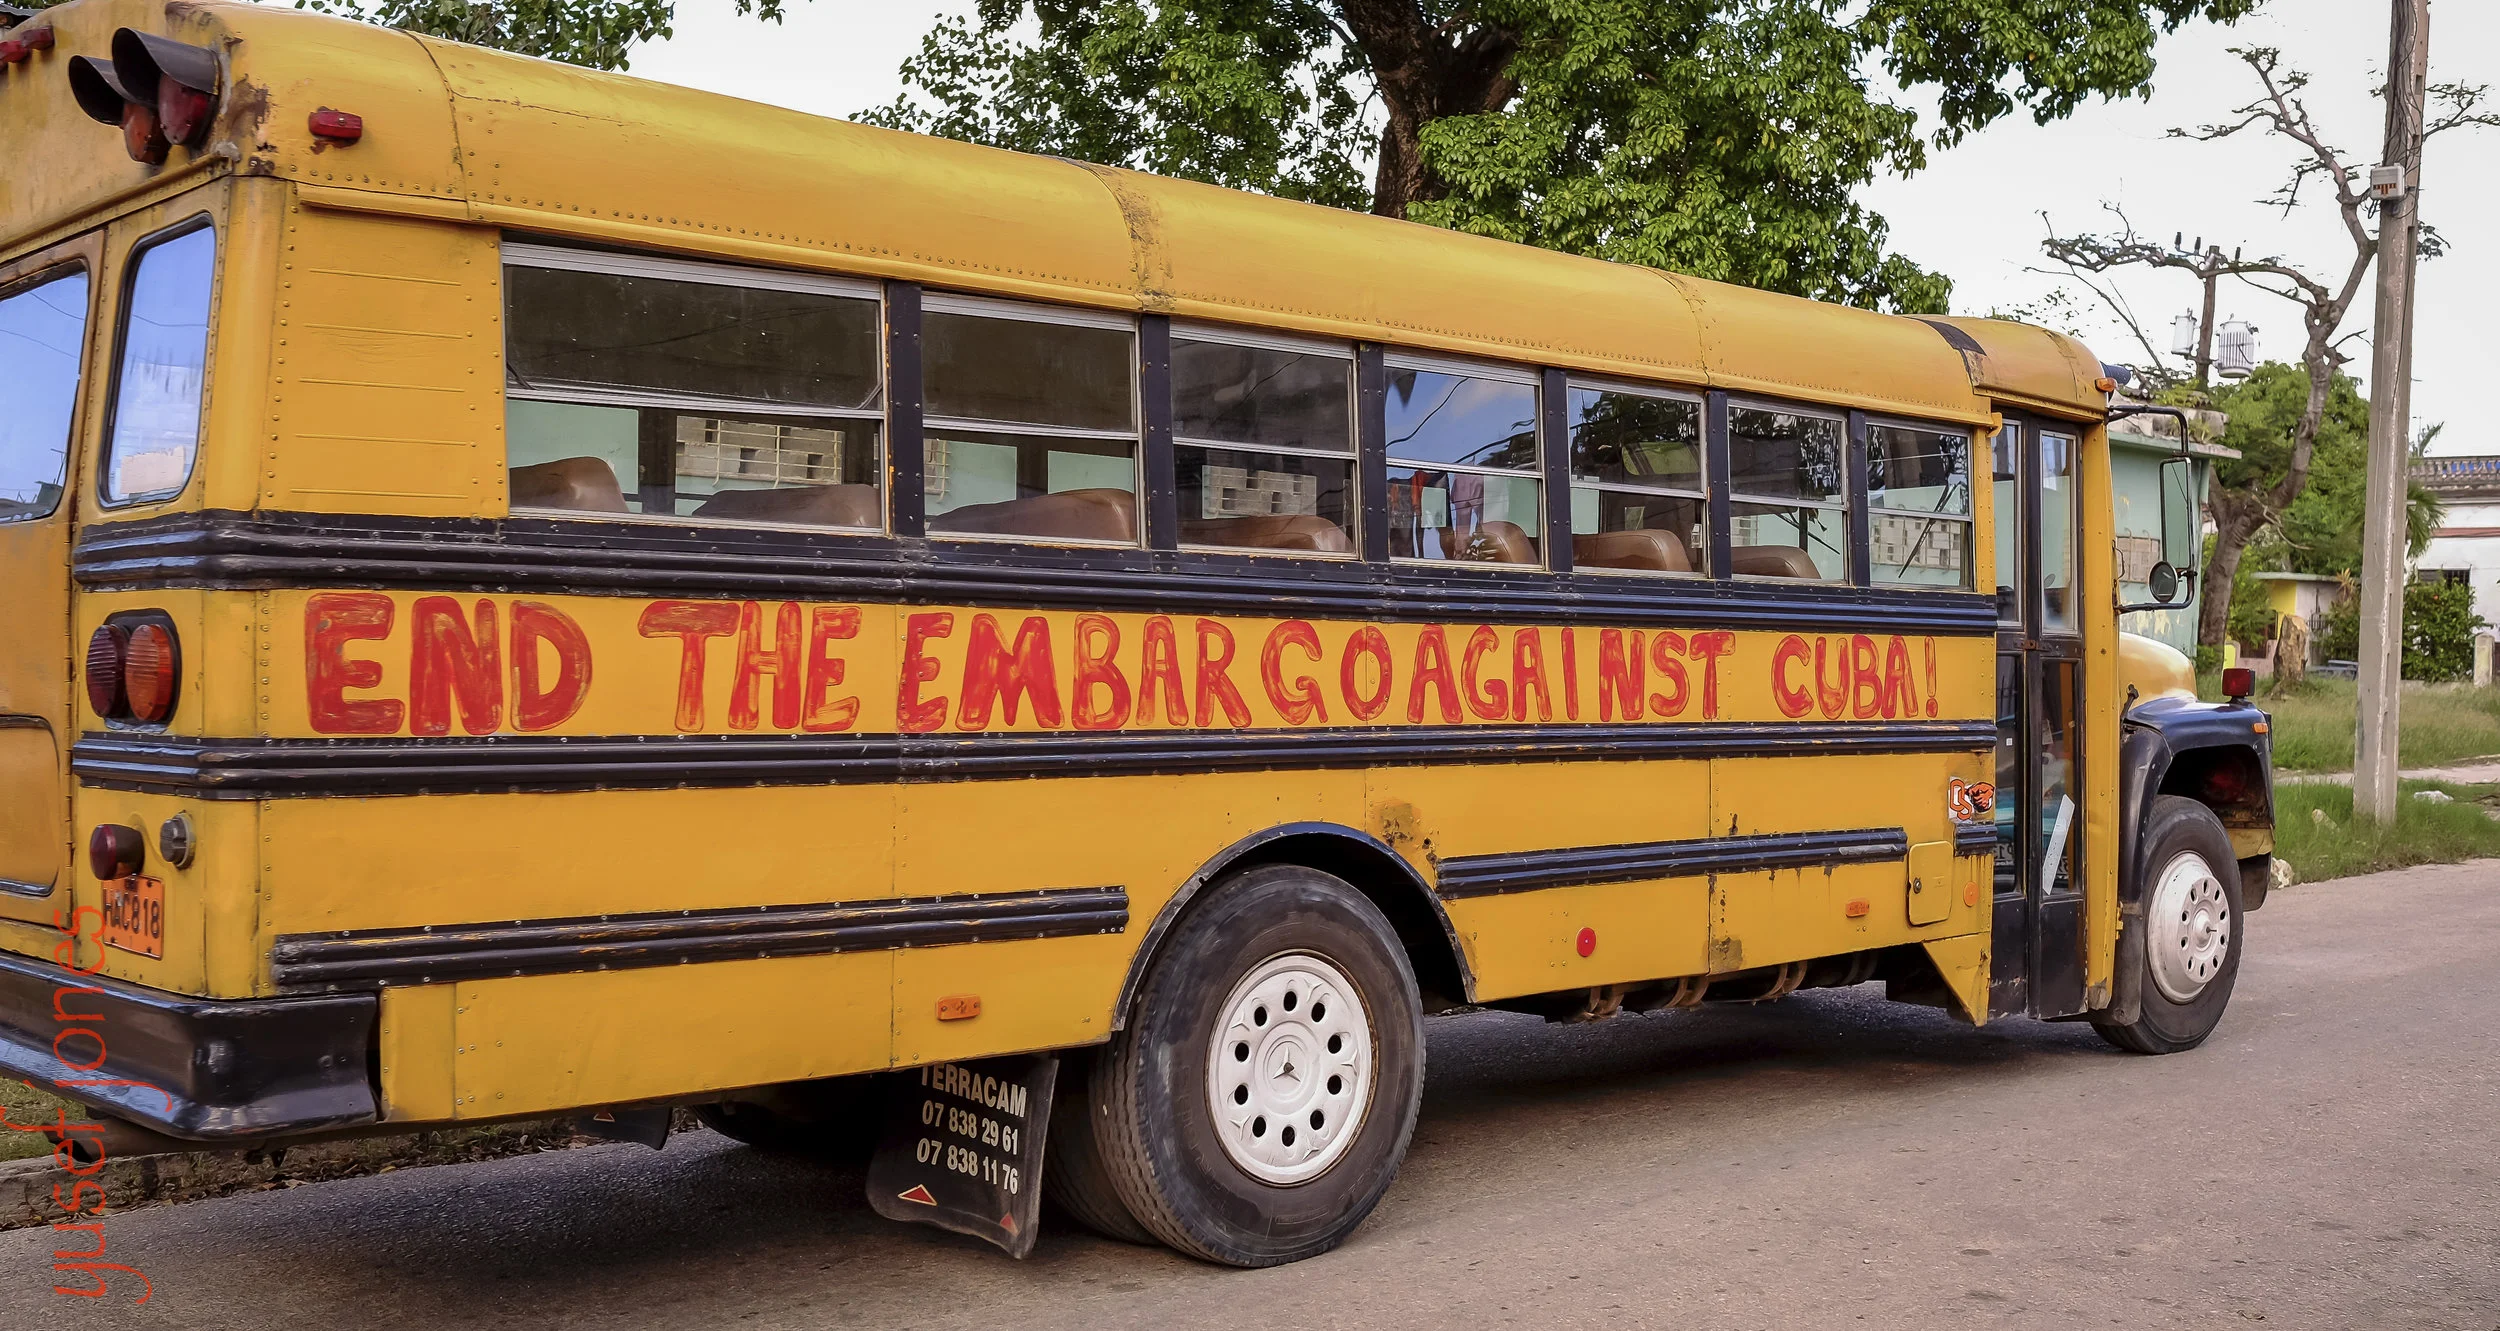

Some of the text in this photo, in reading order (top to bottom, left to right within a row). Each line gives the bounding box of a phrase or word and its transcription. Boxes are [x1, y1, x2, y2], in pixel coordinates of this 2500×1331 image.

[304, 591, 593, 737] END
[637, 599, 862, 734] THE
[1771, 633, 1939, 720] CUBA!
[922, 1100, 1018, 1155] 07 838 29 61
[916, 1137, 1019, 1195] 07 838 11 76
